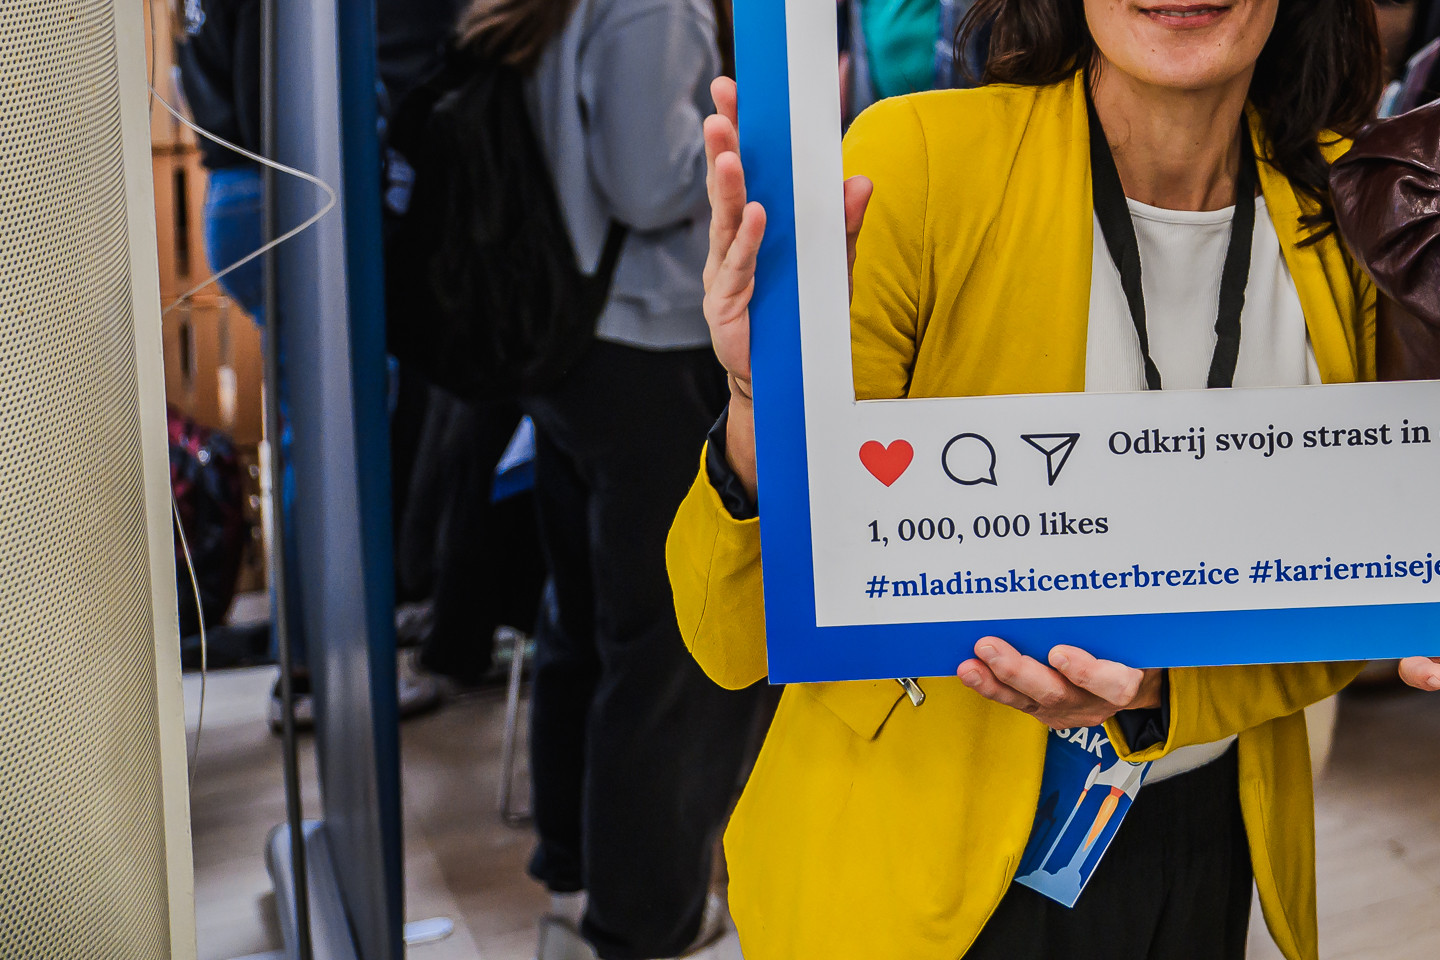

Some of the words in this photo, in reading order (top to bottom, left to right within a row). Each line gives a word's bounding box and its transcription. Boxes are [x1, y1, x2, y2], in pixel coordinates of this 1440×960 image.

[1108, 427, 1205, 460] Odkrij
[1216, 424, 1294, 457] svojo
[1303, 424, 1392, 448] strast
[1401, 419, 1431, 443] in
[868, 520, 888, 547] 1,
[898, 517, 964, 544] 000,
[973, 515, 1030, 538] 000
[1039, 512, 1108, 536] likes
[865, 562, 1240, 598] #mladinskicenterbrezice
